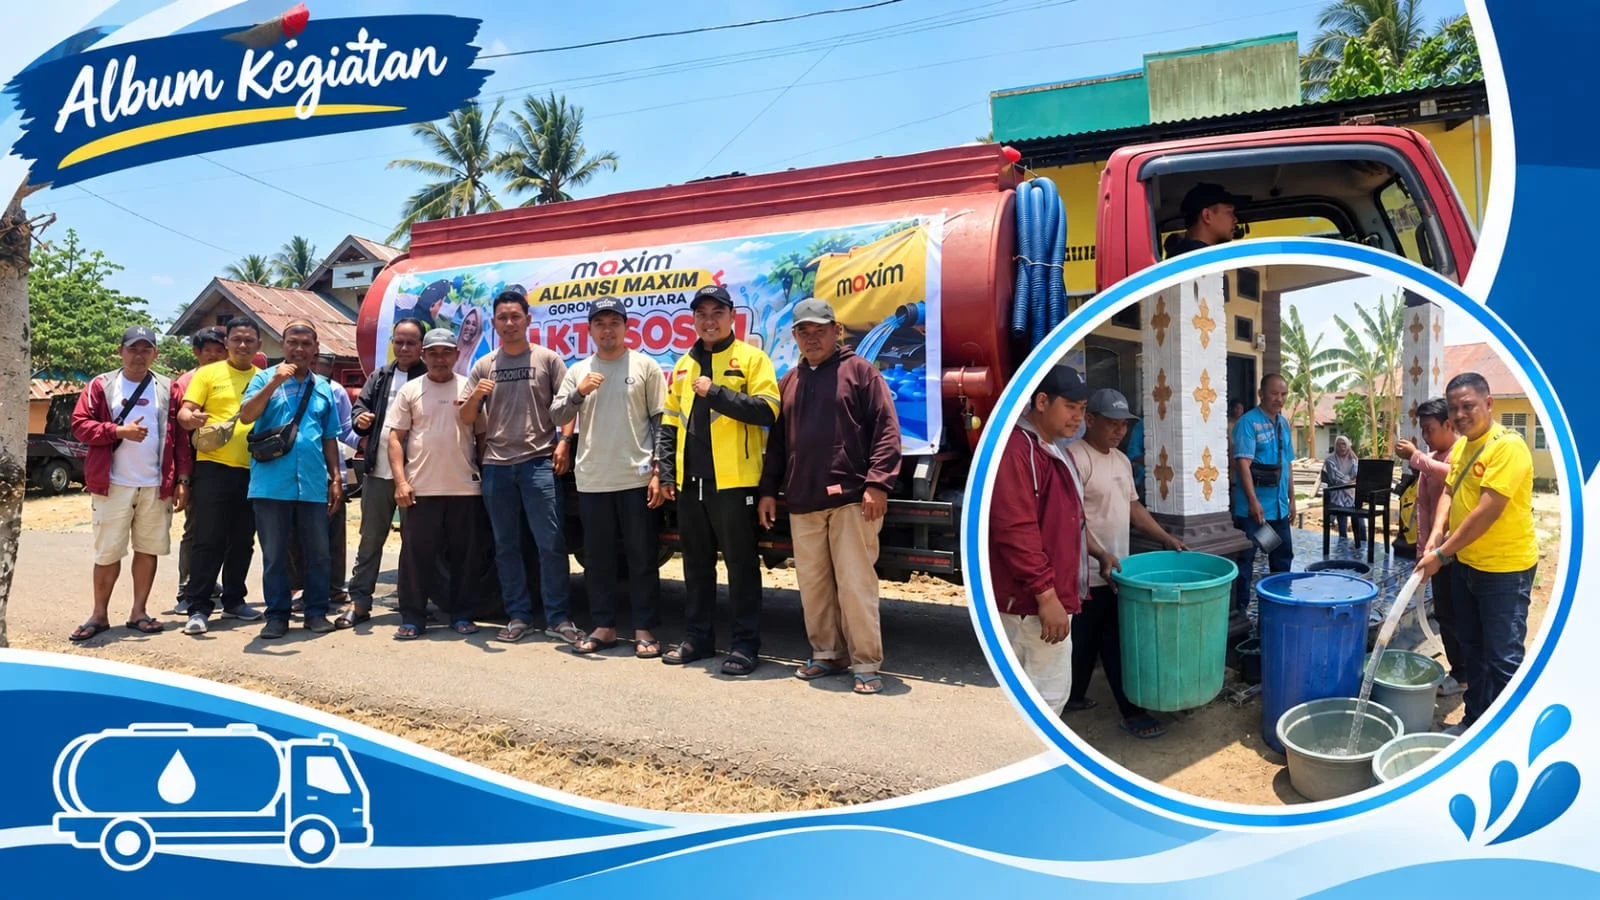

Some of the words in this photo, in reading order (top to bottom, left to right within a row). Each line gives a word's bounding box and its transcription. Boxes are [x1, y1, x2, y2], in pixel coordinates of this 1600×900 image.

[571, 250, 673, 280] maxim
[836, 262, 904, 297] maxim
[539, 279, 618, 302] ALIANSI
[622, 271, 699, 293] MAXIM
[637, 292, 687, 307] UTARA
